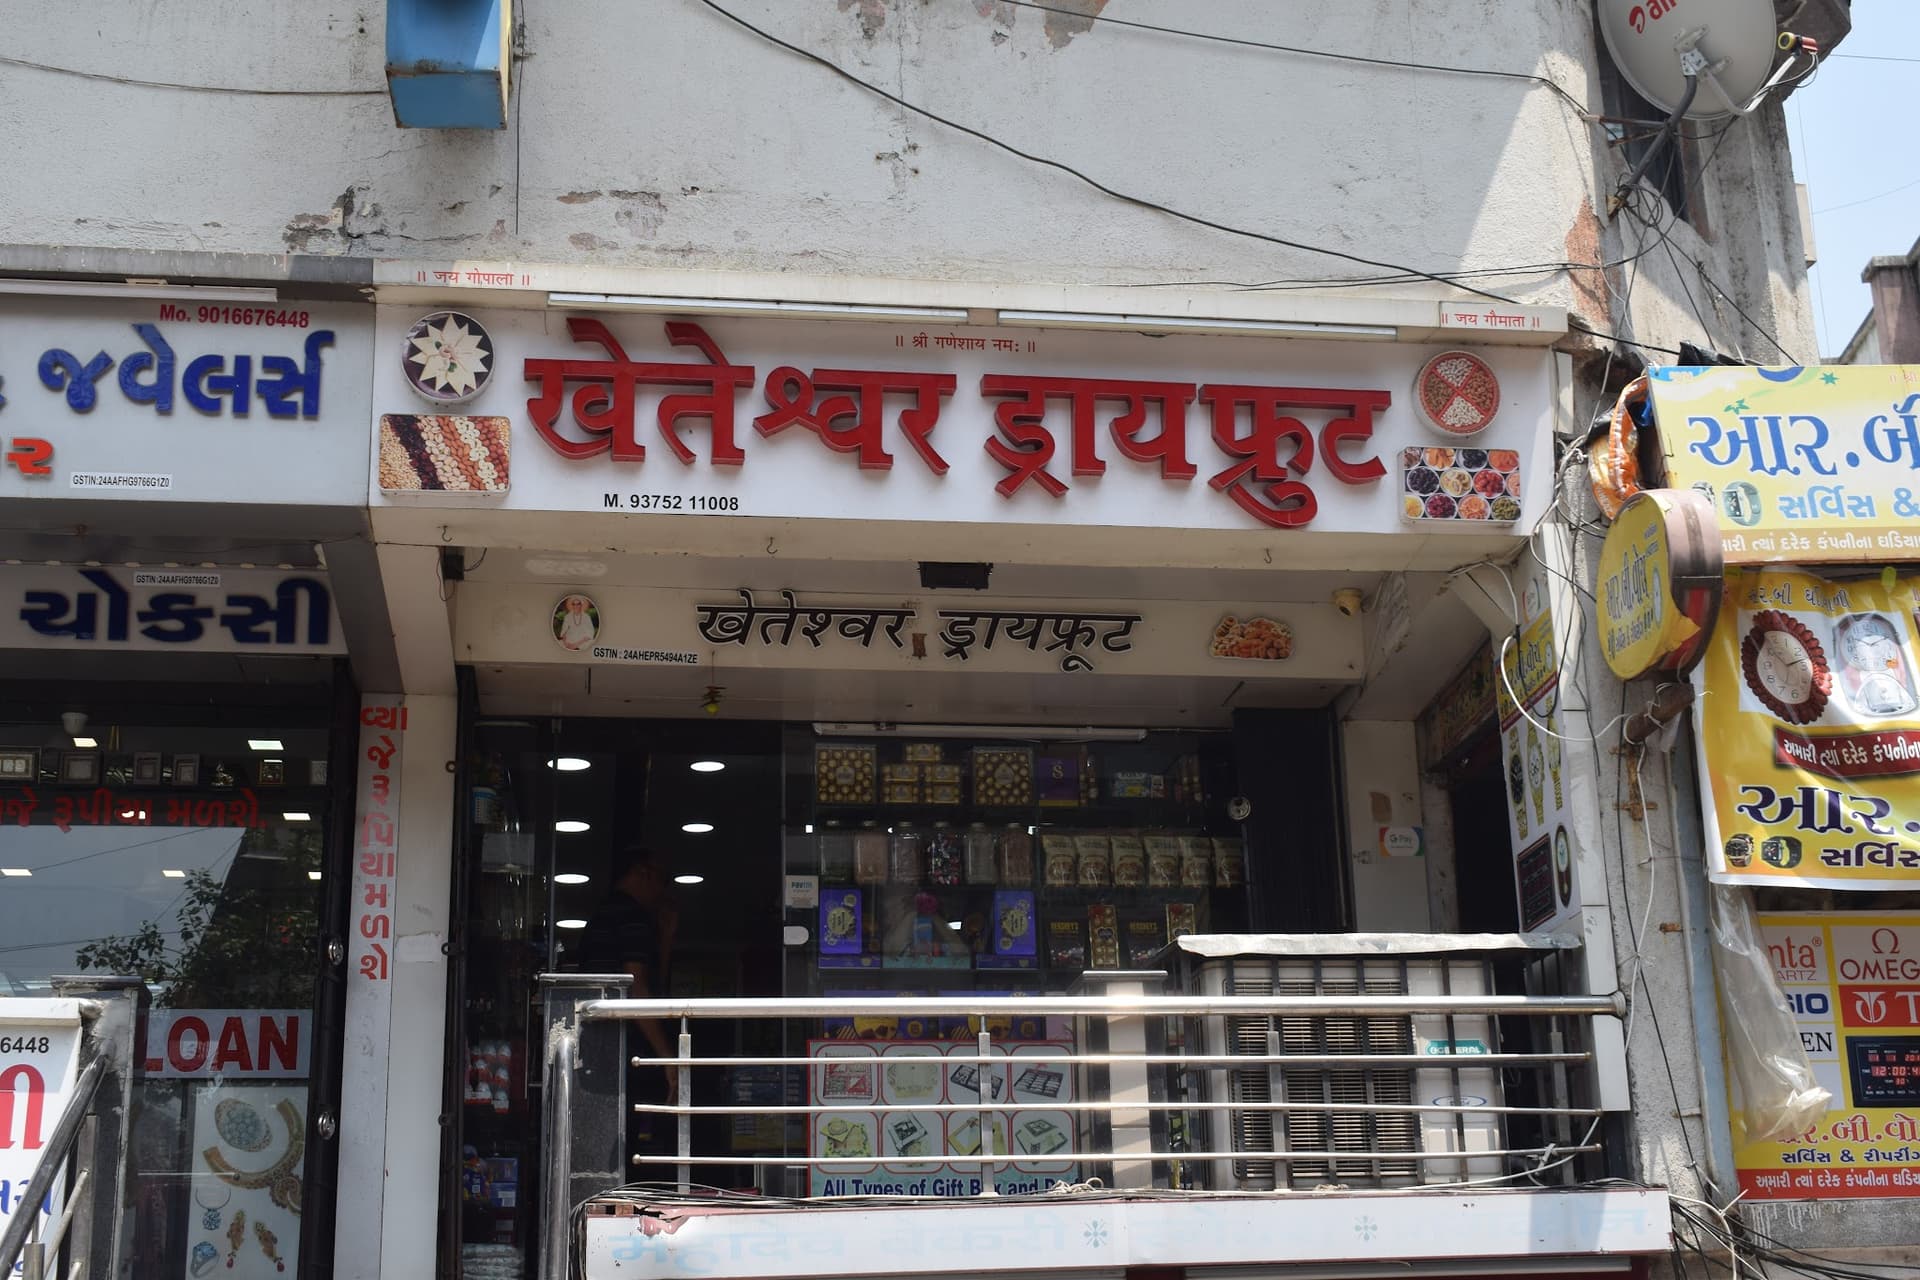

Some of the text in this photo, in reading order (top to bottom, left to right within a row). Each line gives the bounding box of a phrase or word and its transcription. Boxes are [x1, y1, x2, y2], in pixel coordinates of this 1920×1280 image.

[433, 271, 460, 283] जय
[466, 267, 515, 286] गोपाला
[160, 304, 310, 328] Mo. 9016676448
[1454, 313, 1478, 326] जय
[1483, 309, 1525, 327] गौमाता
[912, 332, 928, 348] श्री
[934, 333, 986, 351] गणेशाय
[524, 316, 957, 475] खेतेश्वर
[603, 493, 740, 511] M. 93752 11008
[1777, 485, 1920, 519] સર્વિસ &
[1780, 532, 1811, 551] દરેક
[1817, 531, 1872, 550] કંપનીના
[1878, 530, 1920, 549] ઘડિયા
[19, 569, 331, 646] ચોકસી
[696, 589, 917, 648] खेतेश्वर
[593, 647, 617, 659] GSTIN
[1783, 739, 1818, 765] અમારી
[1842, 740, 1868, 765] દરેક
[144, 1016, 299, 1072] LOAN
[1781, 1148, 1831, 1163] સર્વિસ
[1840, 1149, 1855, 1162] &
[824, 1179, 846, 1196] All
[910, 1179, 926, 1196] of
[932, 1178, 963, 1196] Gift
[970, 1179, 1001, 1196] Bx
[1008, 1177, 1039, 1195] and
[1755, 1171, 1791, 1189] અમારી
[1817, 1168, 1841, 1187] દરેક
[1845, 1167, 1889, 1187] કંપનીના
